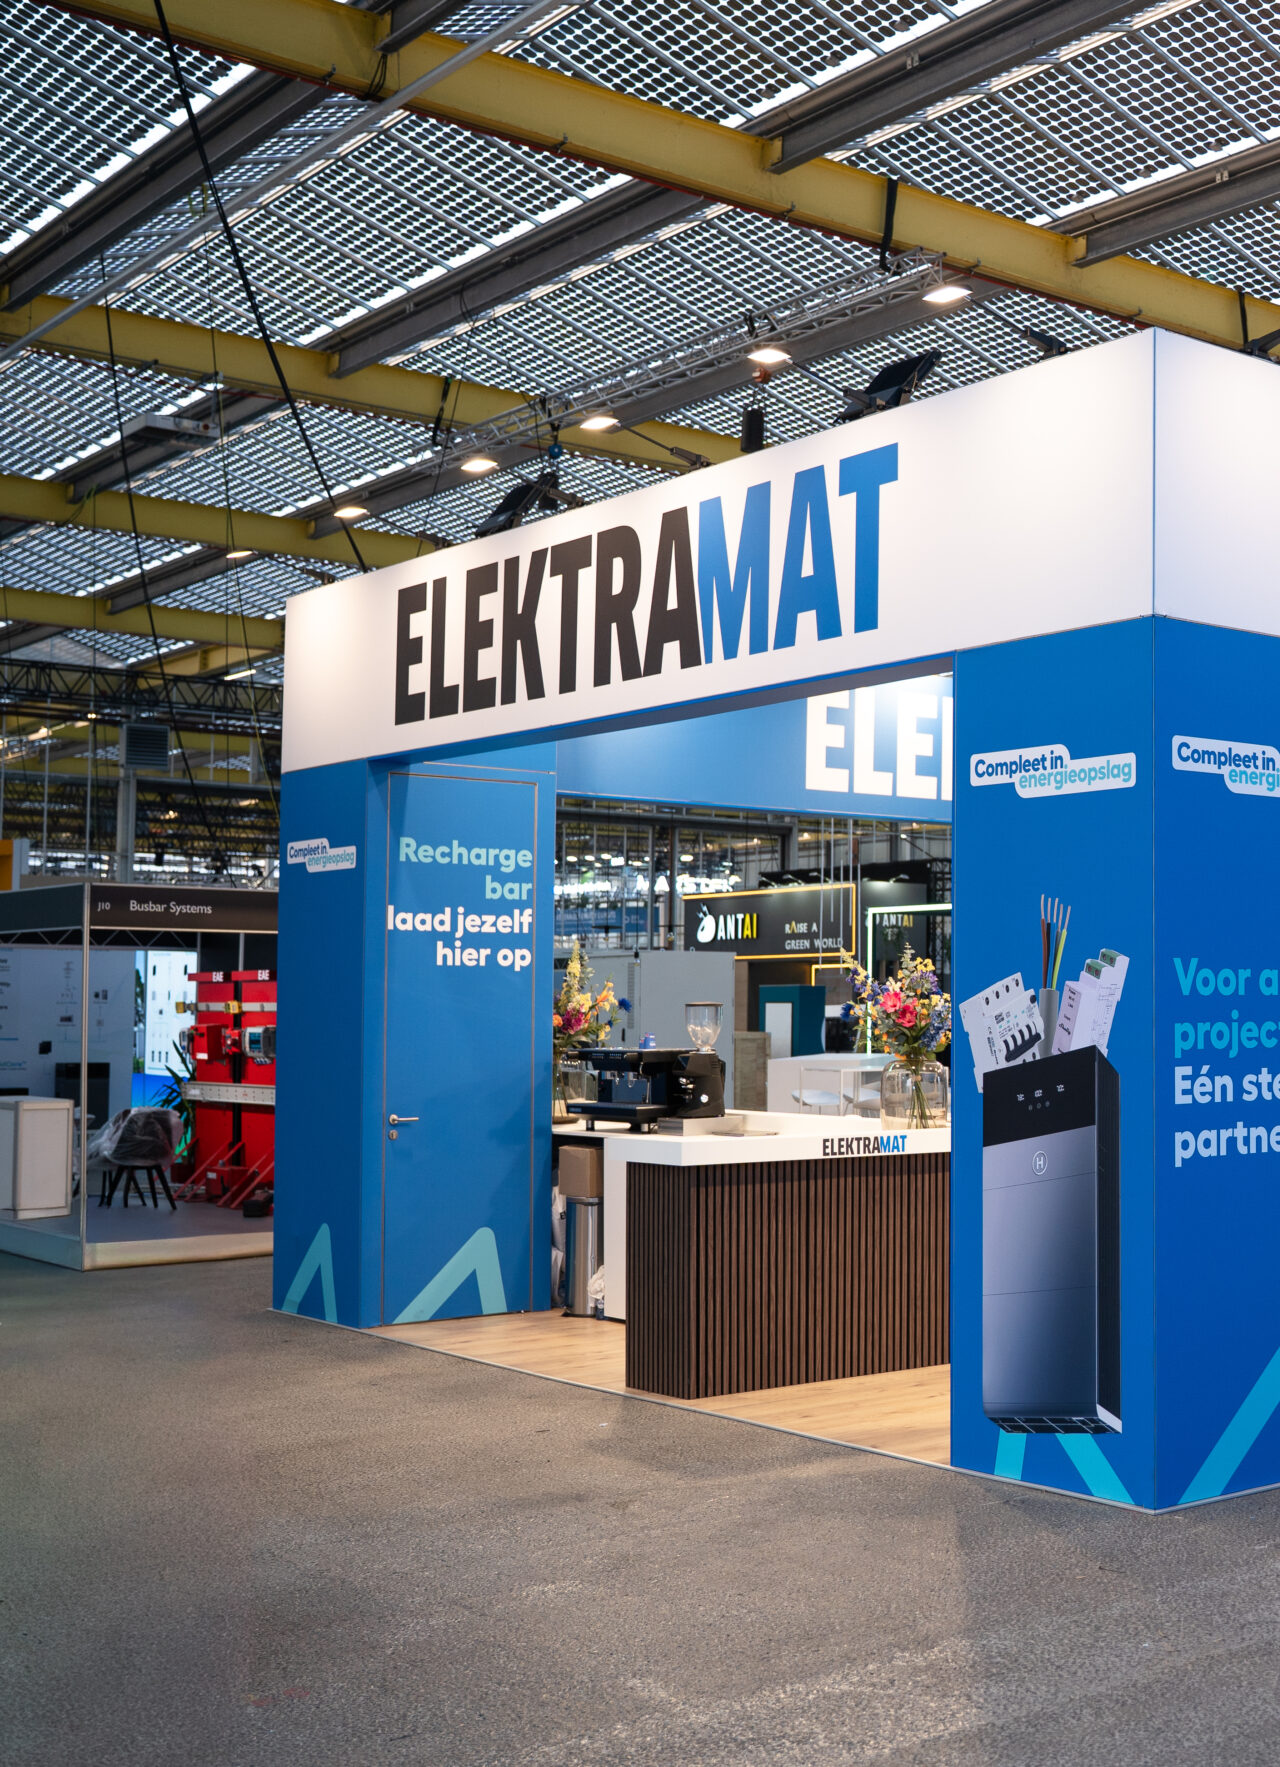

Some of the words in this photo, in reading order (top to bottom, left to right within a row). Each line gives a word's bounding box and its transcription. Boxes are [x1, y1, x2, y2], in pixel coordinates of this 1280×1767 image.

[395, 443, 899, 726] ELEKTRAMAT
[974, 753, 1047, 778] Compleet
[1050, 750, 1064, 770] in
[1177, 742, 1258, 769] Compleet
[1262, 750, 1276, 771] in
[1019, 760, 1132, 790] energieopslag
[289, 844, 319, 859] Compleet
[320, 842, 327, 855] in
[307, 849, 354, 868] energieopslag
[400, 837, 533, 873] Recharge
[485, 875, 533, 900] bar
[98, 902, 110, 911] J10
[130, 900, 167, 912] Busbar
[170, 902, 212, 916] Systems
[387, 904, 451, 931] laad
[455, 906, 533, 938] jezelf
[717, 912, 757, 940] ANTAI
[785, 921, 808, 933] RAISE
[811, 922, 818, 933] A
[883, 914, 914, 928] ANTAI
[437, 941, 490, 966] hier
[497, 949, 531, 972] op
[785, 939, 810, 951] GREEN
[813, 937, 844, 949] WORLD
[212, 971, 224, 982] EAE
[258, 969, 270, 981] EAE
[1173, 957, 1251, 996] Voor
[1174, 1064, 1234, 1105] Eén
[822, 1135, 907, 1157] ELEKTRAMAT
